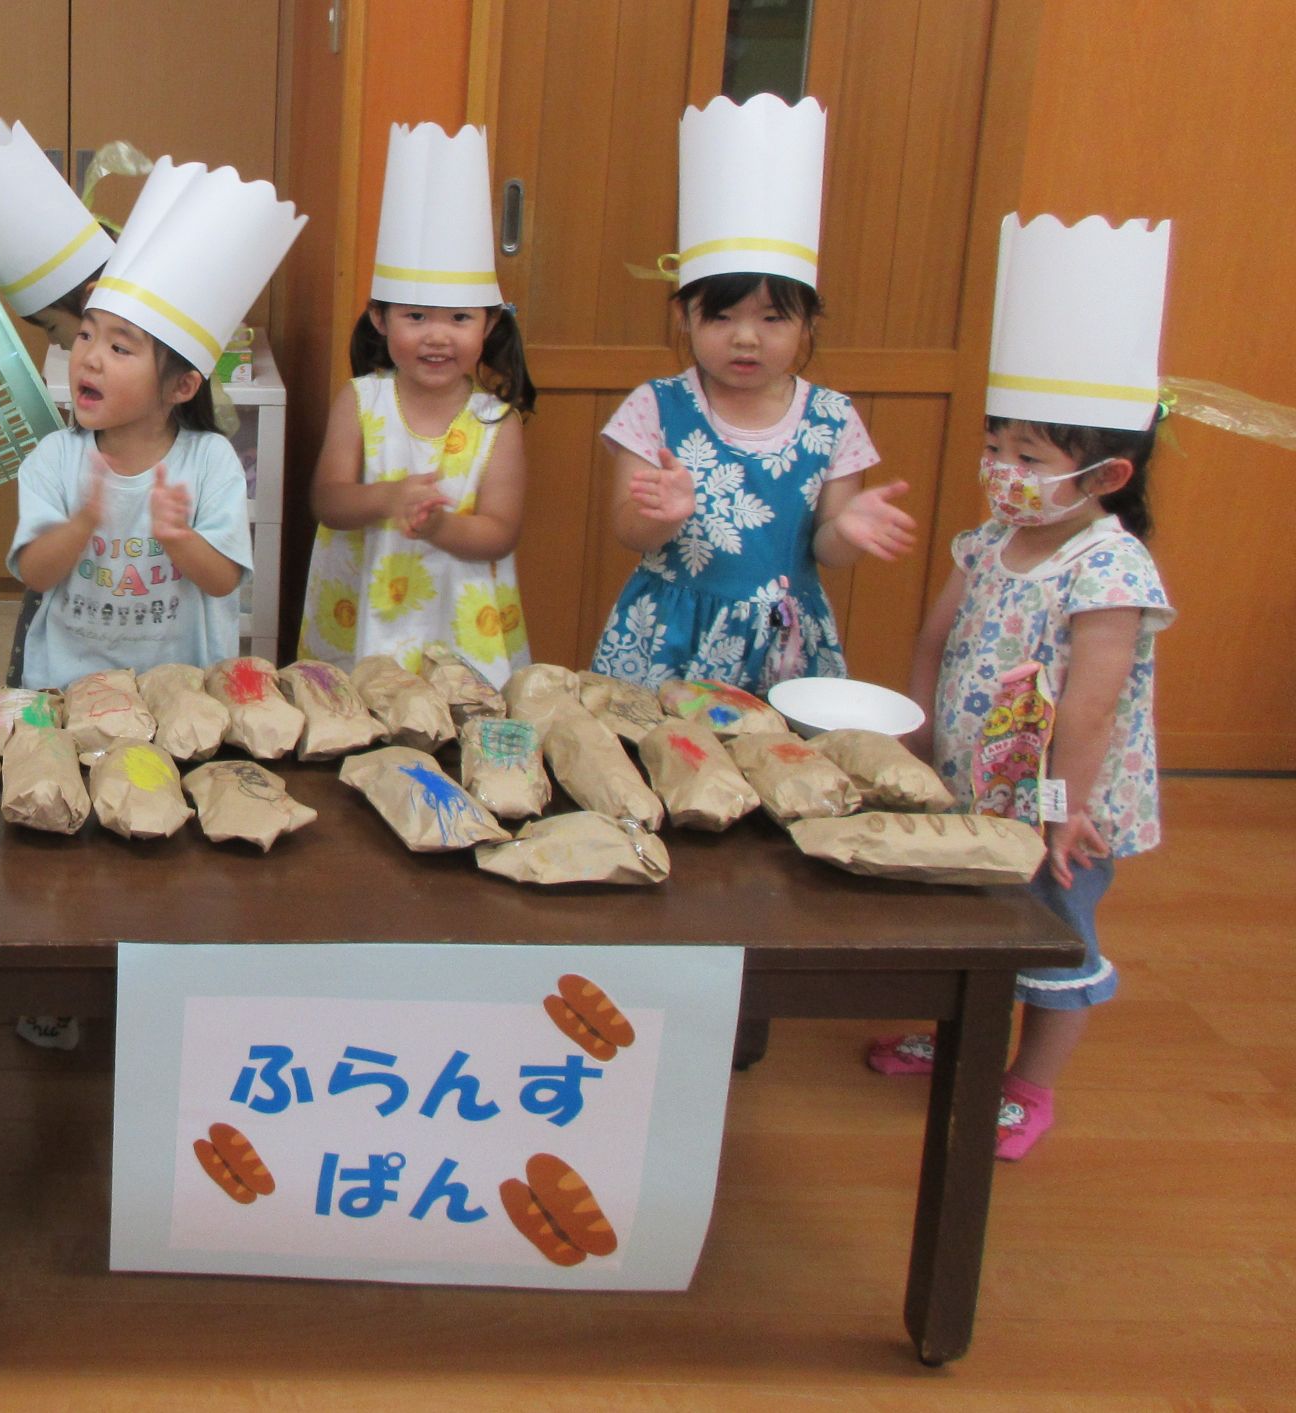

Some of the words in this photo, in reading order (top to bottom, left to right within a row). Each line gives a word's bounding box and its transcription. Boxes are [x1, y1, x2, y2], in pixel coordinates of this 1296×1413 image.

[230, 1045, 603, 1127] ふらんす
[316, 1151, 489, 1223] ぱん
